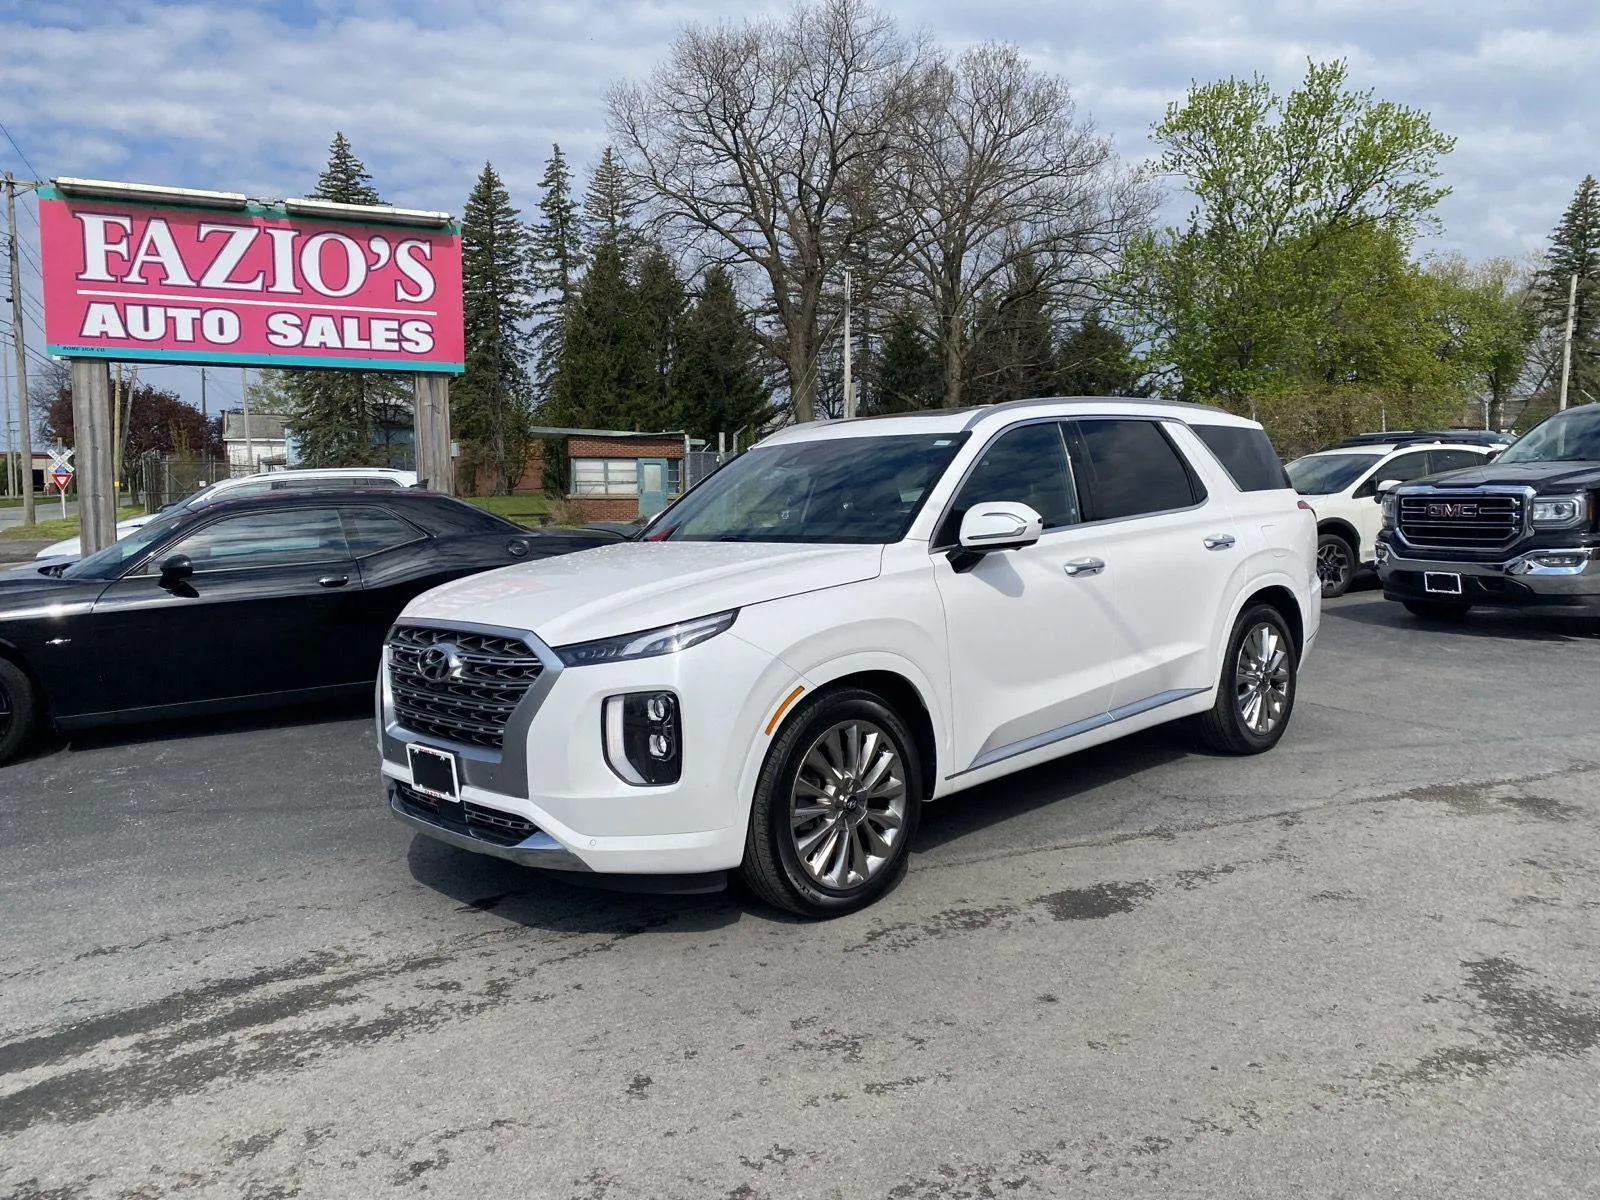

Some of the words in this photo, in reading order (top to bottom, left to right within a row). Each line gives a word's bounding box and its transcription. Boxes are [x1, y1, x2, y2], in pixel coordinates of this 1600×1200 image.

[73, 211, 436, 303] FAZIO'S
[80, 302, 240, 344] AUTO
[266, 311, 435, 354] SALES
[1428, 503, 1477, 517] GMC
